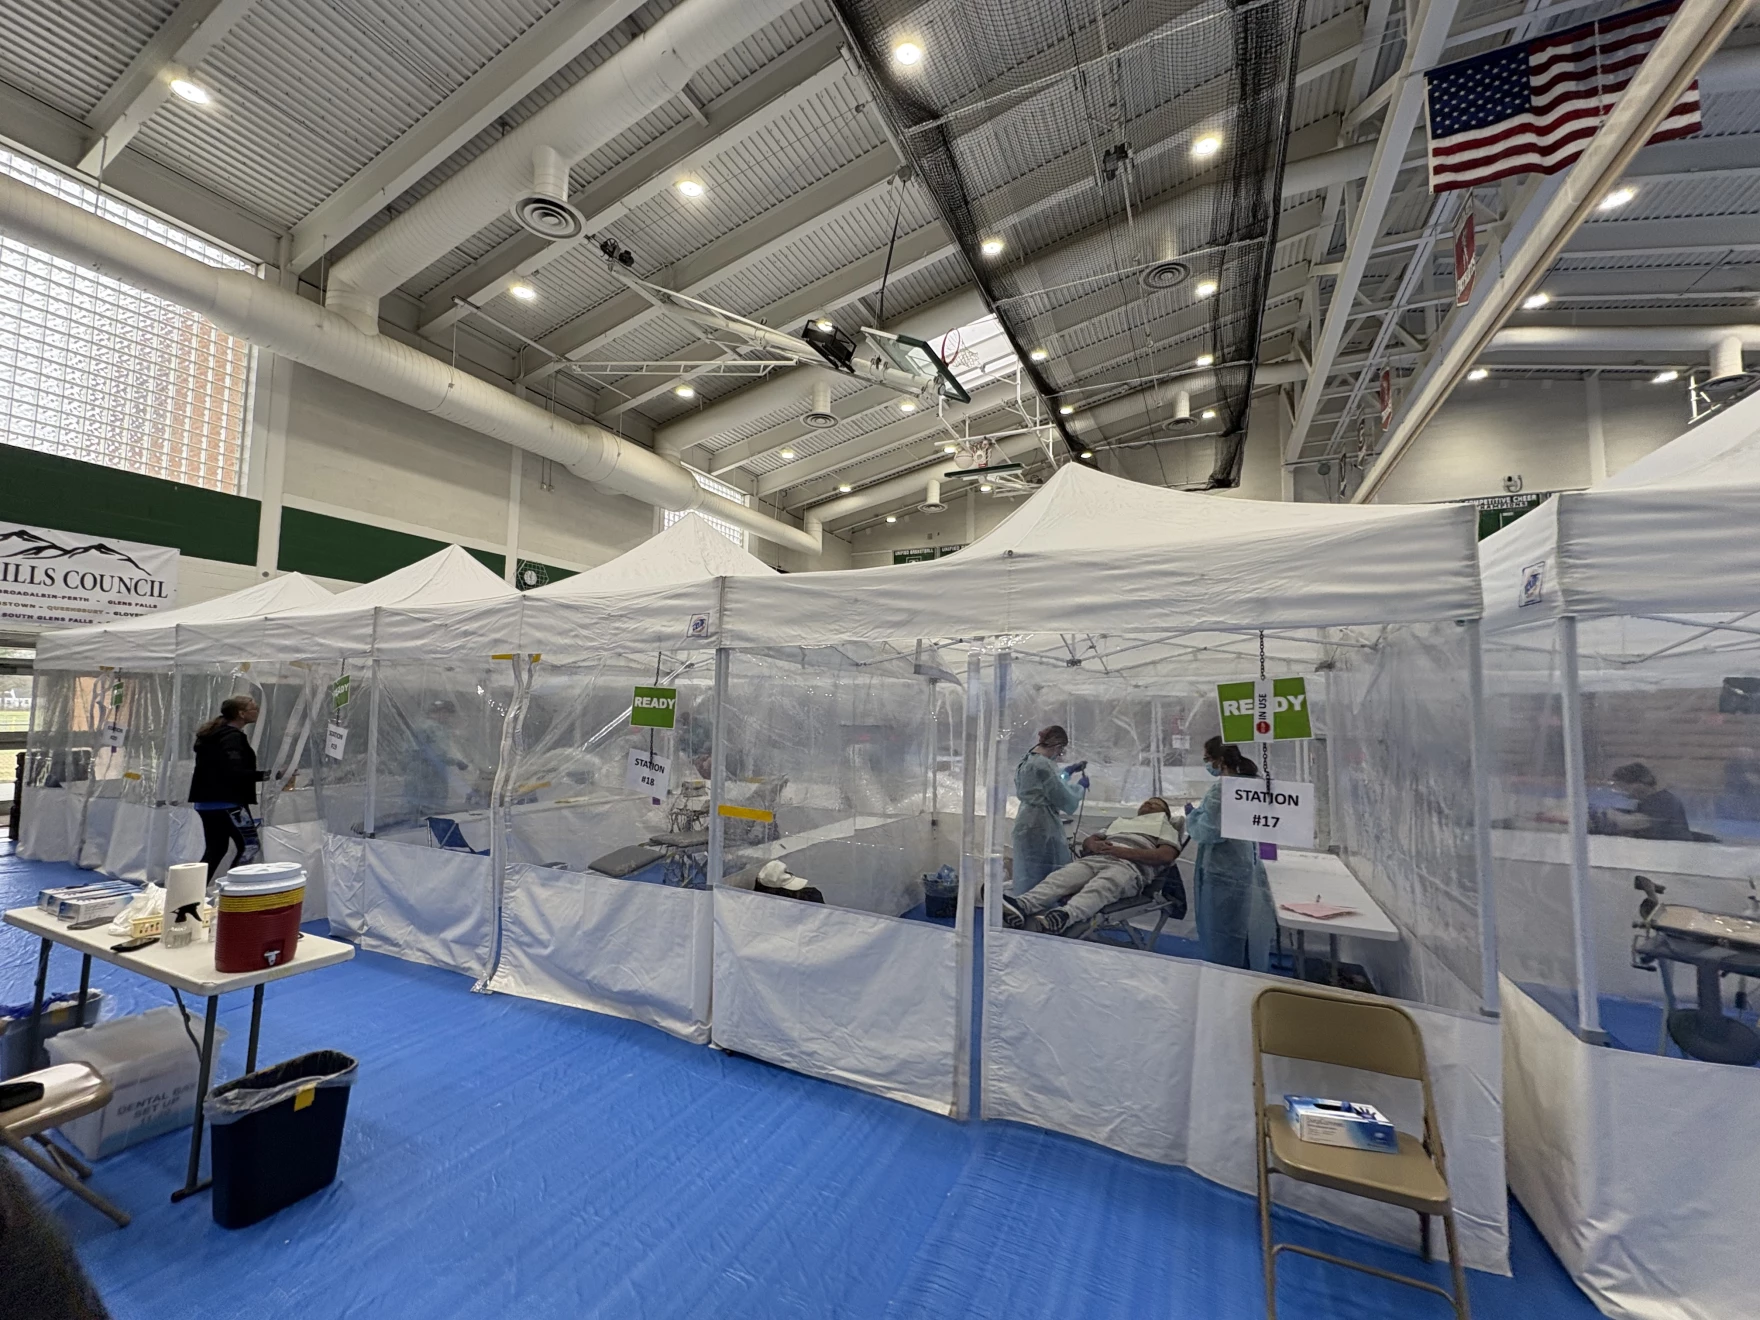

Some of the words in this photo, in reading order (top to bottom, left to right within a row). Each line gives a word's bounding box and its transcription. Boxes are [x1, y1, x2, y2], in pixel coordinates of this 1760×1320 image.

[1512, 494, 1537, 502] CHEER
[63, 570, 169, 599] COUNCIL
[1, 612, 35, 620] SOUTH
[46, 605, 104, 615] QUEENSBURY
[634, 696, 676, 710] READY
[1222, 694, 1306, 717] REDY
[1258, 693, 1267, 709] USE
[1258, 711, 1267, 721] IN
[634, 757, 666, 775] STATION
[641, 775, 655, 787] #18
[1234, 788, 1299, 807] STATION
[1252, 814, 1281, 829] #17
[117, 1092, 167, 1116] DENTAL
